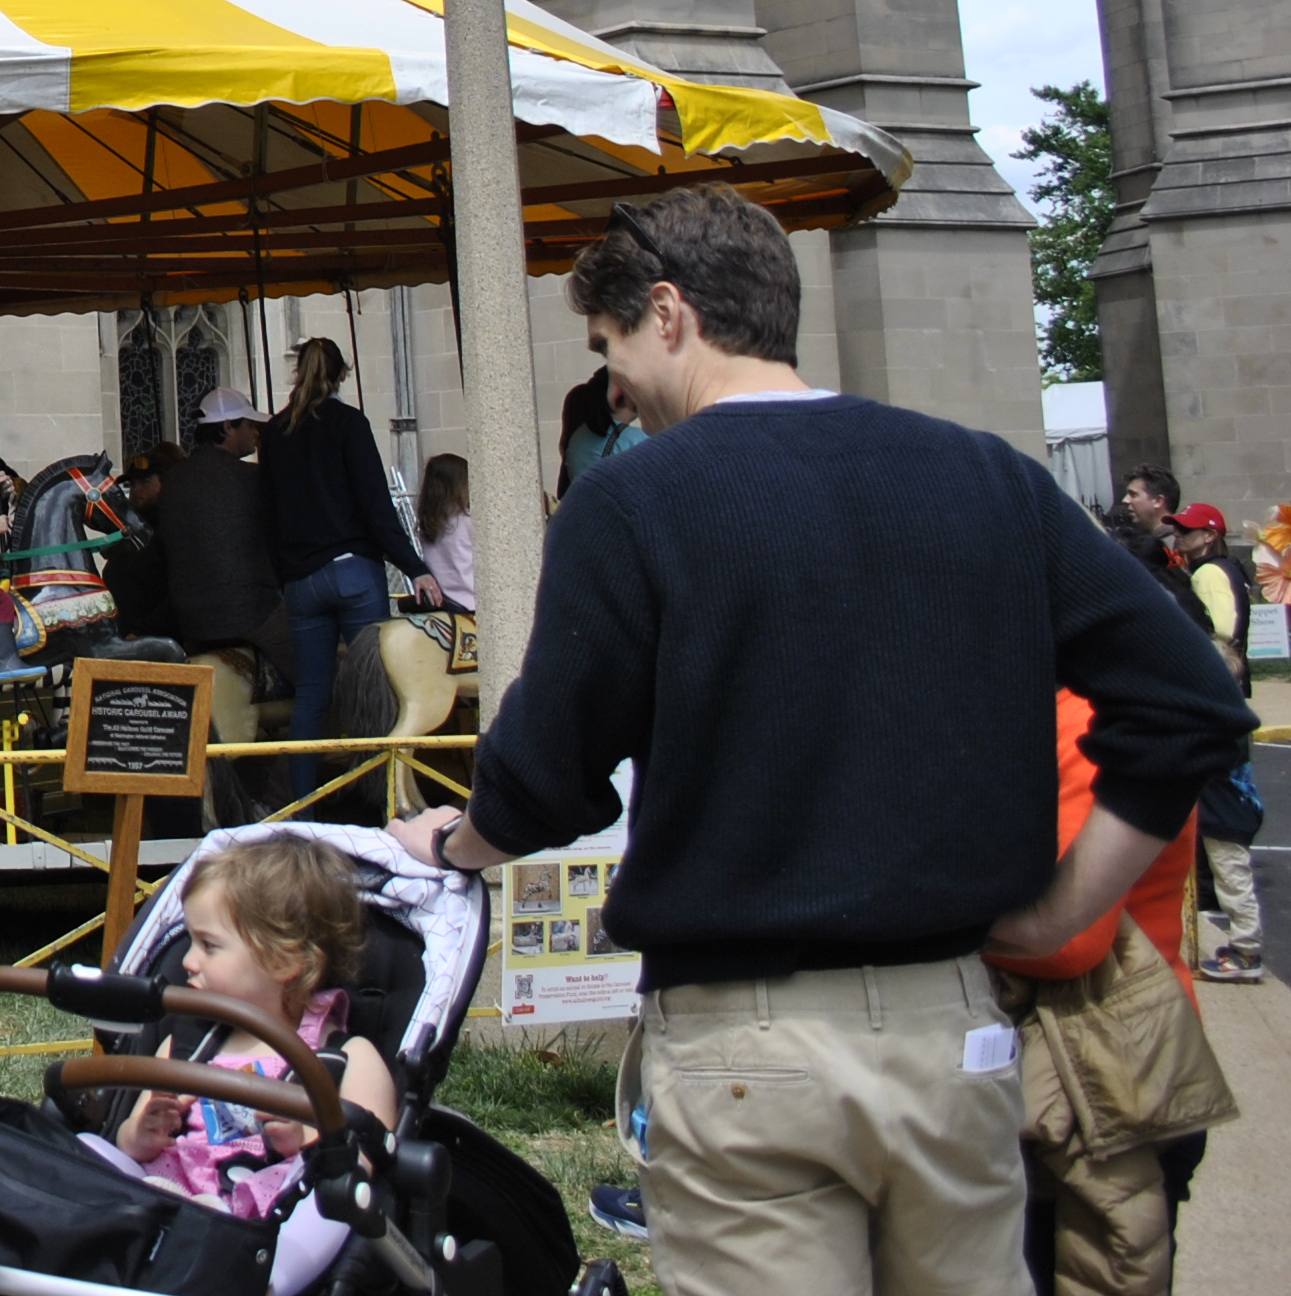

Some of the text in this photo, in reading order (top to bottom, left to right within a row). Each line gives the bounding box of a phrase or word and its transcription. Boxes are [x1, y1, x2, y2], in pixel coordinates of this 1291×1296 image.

[91, 707, 188, 719] HISTORIC CAROUSEL AWARD
[565, 973, 609, 983] Want to help?
